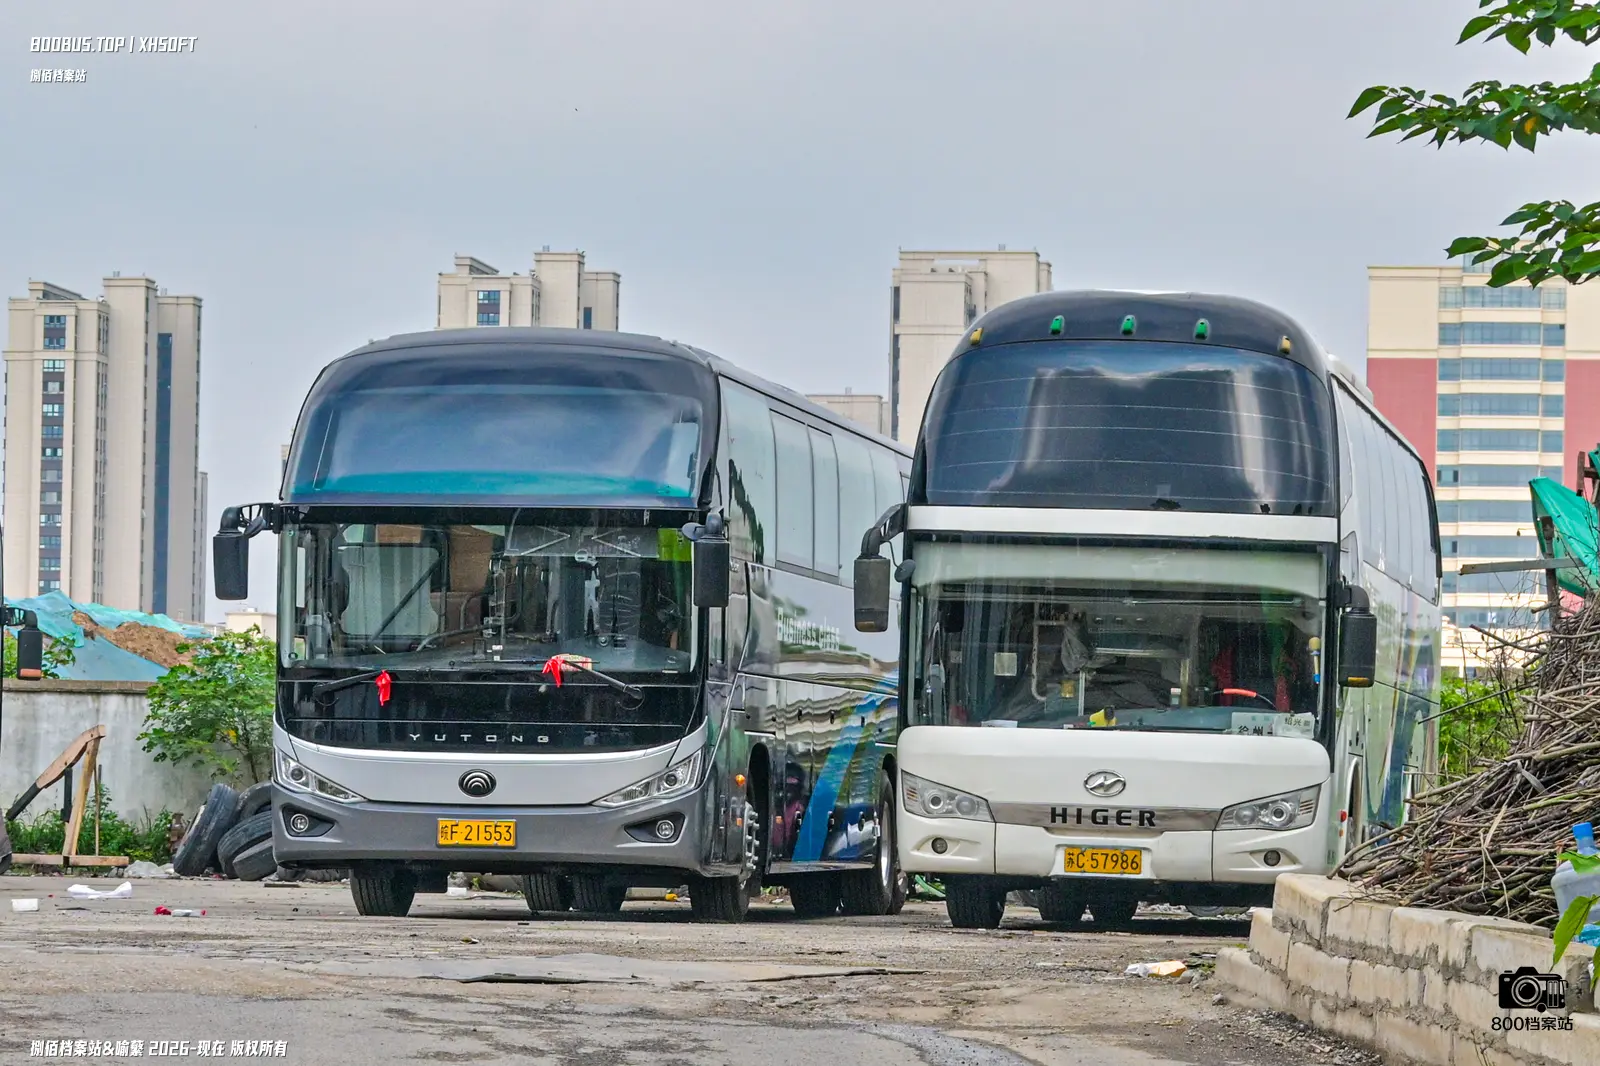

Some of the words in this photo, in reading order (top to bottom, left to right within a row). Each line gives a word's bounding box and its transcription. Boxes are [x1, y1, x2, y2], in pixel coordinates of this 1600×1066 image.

[777, 606, 817, 647] Business
[409, 733, 549, 743] YUTONG
[1050, 807, 1156, 827] HIGER
